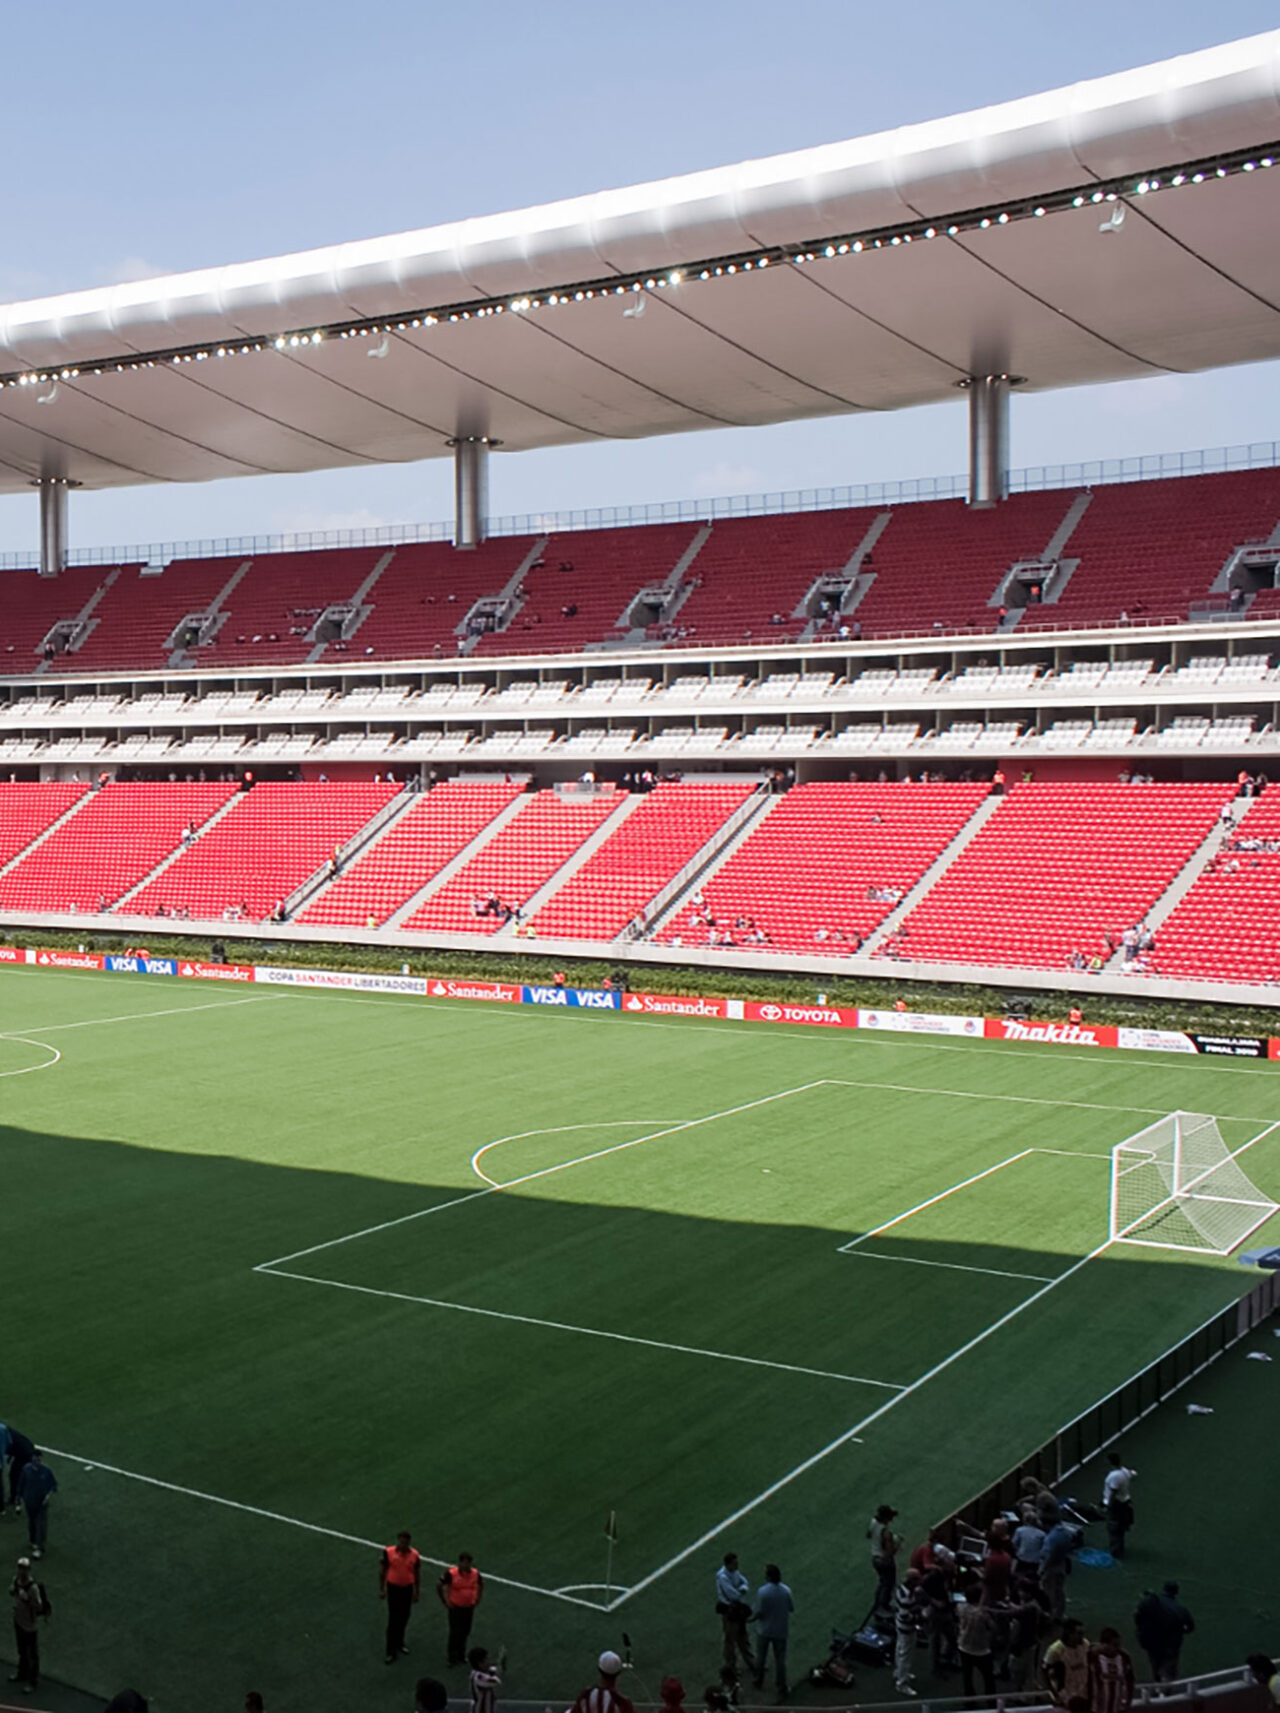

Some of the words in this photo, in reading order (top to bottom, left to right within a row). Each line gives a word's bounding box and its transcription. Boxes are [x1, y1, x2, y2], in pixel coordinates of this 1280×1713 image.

[50, 953, 100, 969] Santander
[110, 957, 139, 972] VISA
[145, 959, 173, 975] VISA
[194, 963, 251, 980] Santander
[269, 971, 294, 981] COPA
[296, 974, 352, 985] SANTANDER
[354, 978, 426, 992] LIBERTADORES
[448, 982, 515, 1001] Santander
[530, 988, 567, 1005] VISA
[576, 991, 614, 1009] VISA
[644, 996, 720, 1016] Santander
[783, 1007, 842, 1024] TOYOTA
